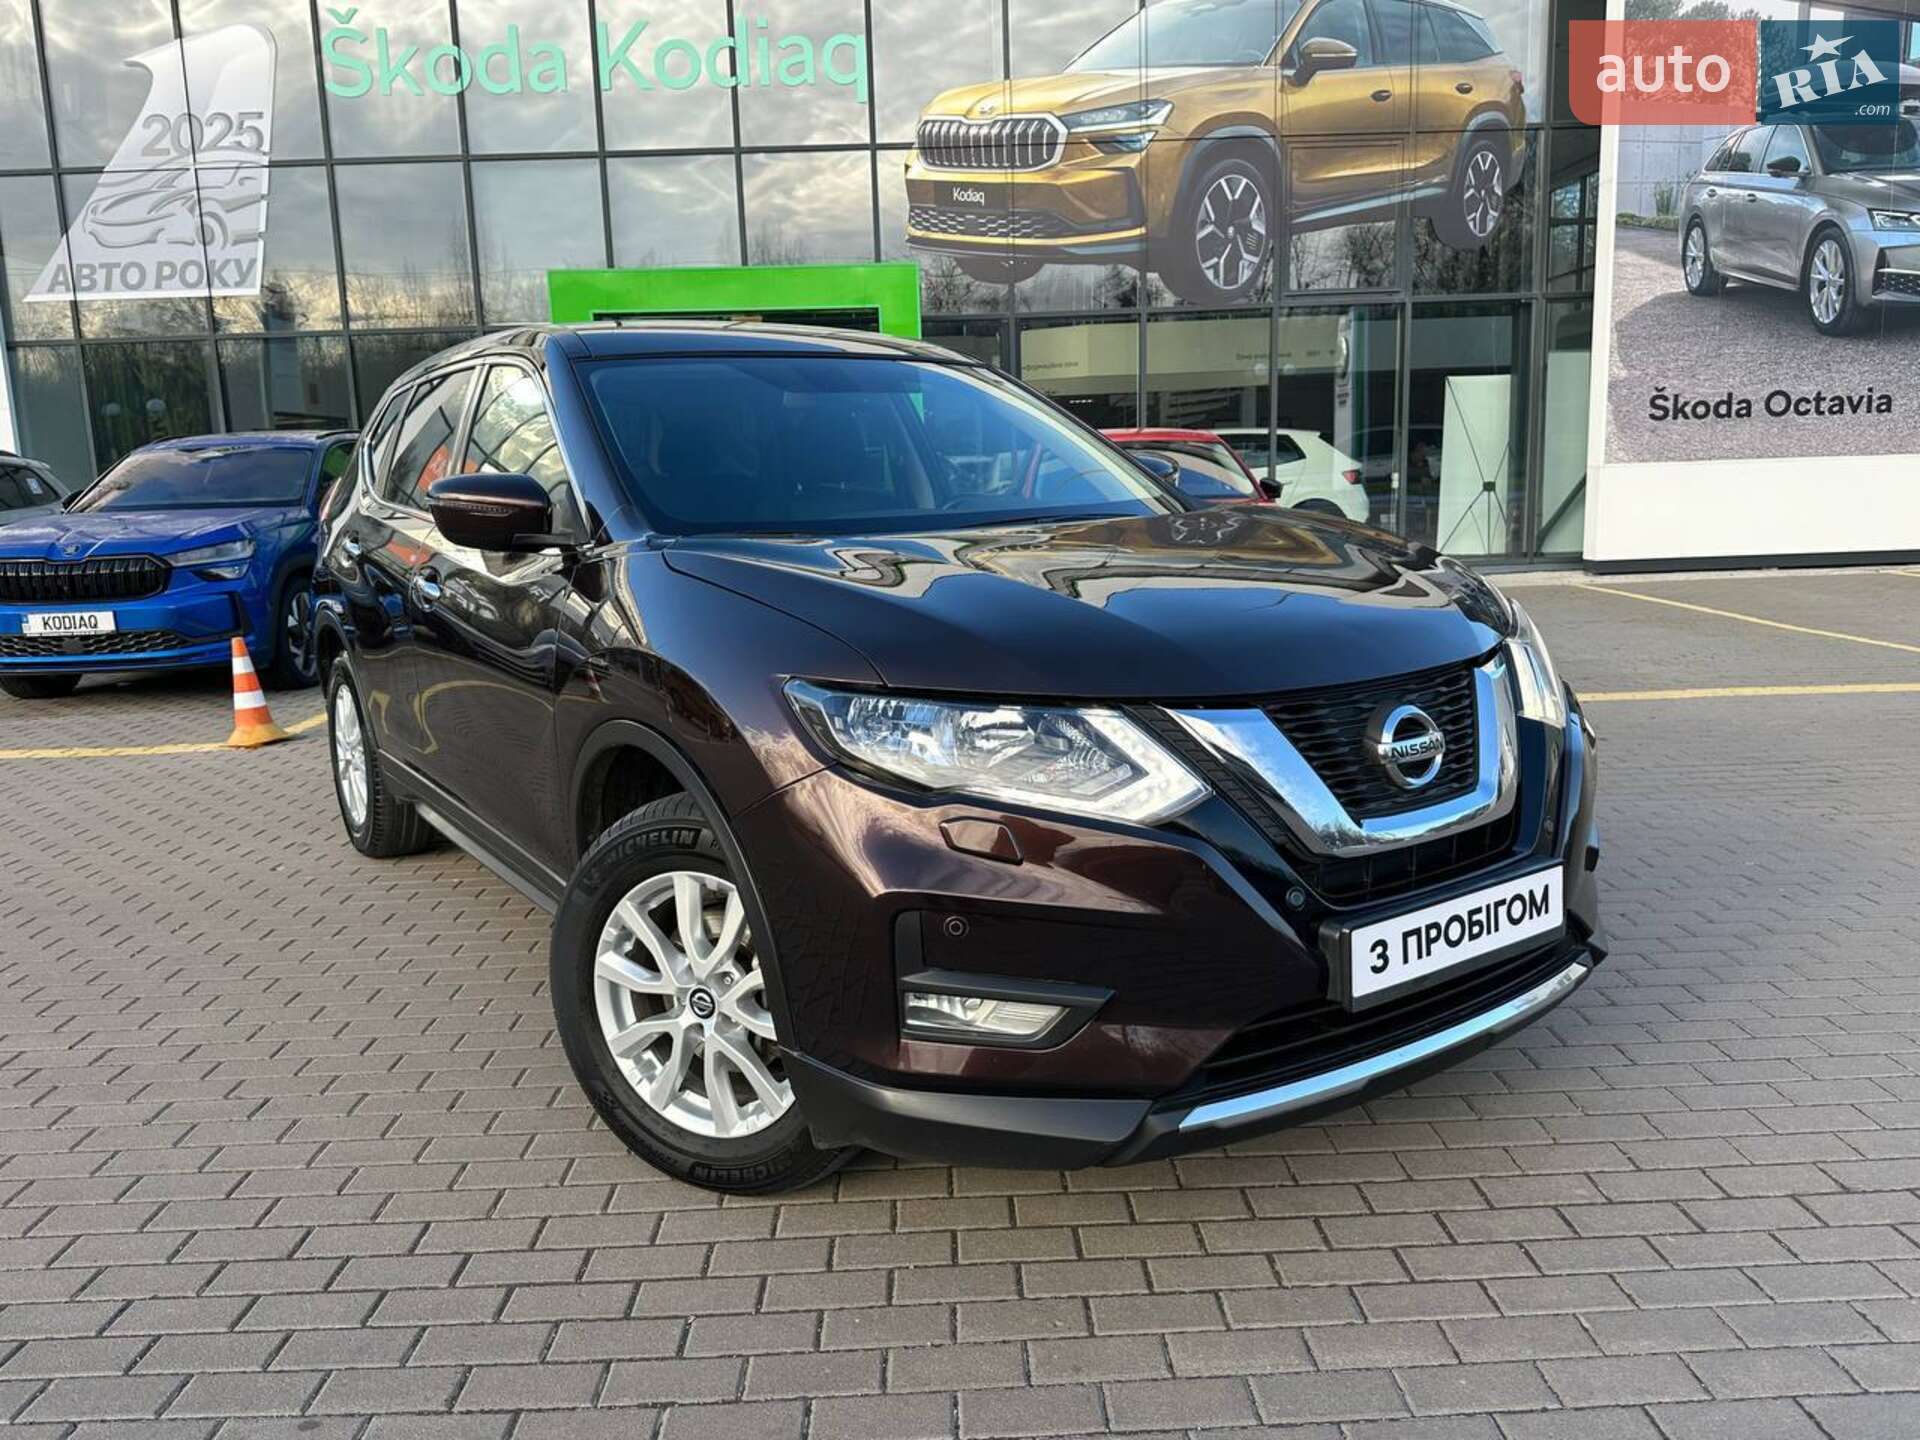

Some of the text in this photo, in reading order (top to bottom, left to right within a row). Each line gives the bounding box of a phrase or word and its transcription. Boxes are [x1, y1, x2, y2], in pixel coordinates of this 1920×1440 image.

[321, 7, 866, 103] Škoda Kodiaq
[142, 112, 264, 156] 2025
[953, 188, 984, 205] Kodiaq
[48, 258, 257, 292] АВТО РОКУ
[1649, 386, 1892, 420] Škoda Octavia
[42, 615, 98, 630] KODIAQ
[1391, 736, 1443, 757] NISSAN
[1370, 884, 1549, 974] З ПРОБІГОМ
